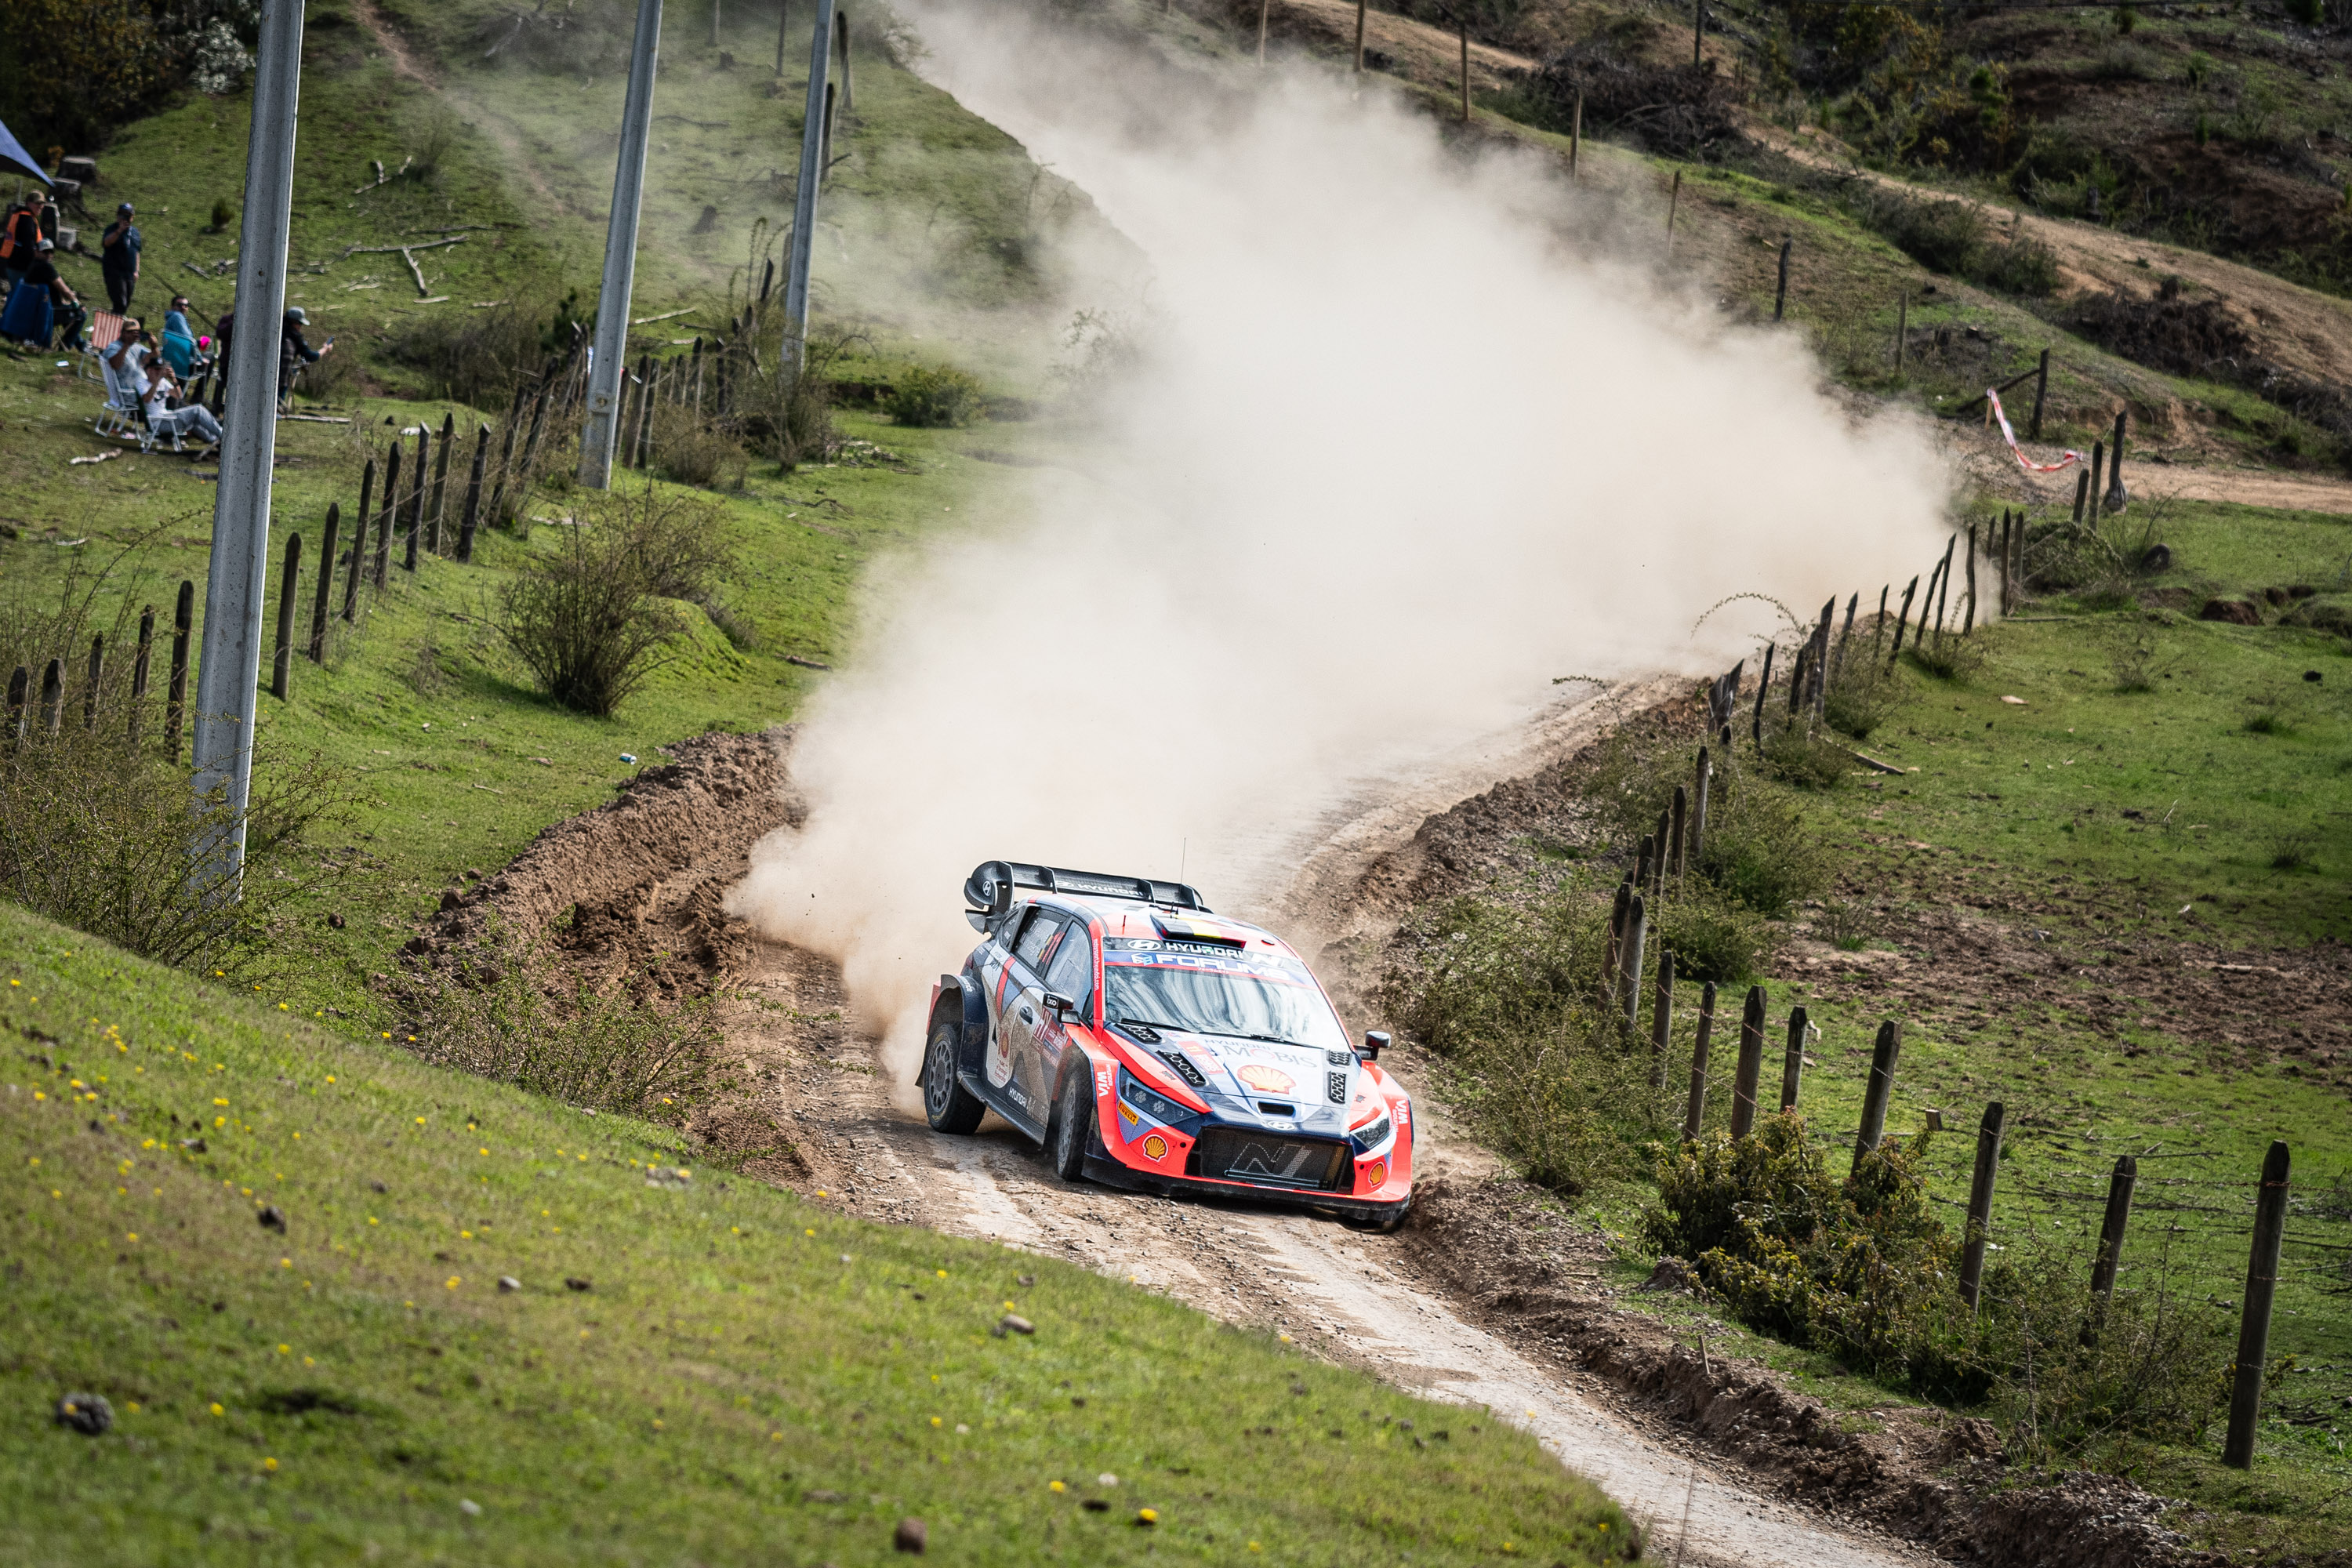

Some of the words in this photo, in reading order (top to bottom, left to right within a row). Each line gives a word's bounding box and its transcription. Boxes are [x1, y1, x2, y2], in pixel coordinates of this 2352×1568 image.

[1165, 942, 1244, 959] HYUNDAI
[1203, 1038, 1272, 1051] HYUNDAI
[1223, 1045, 1318, 1068] MOBIS
[1119, 1101, 1137, 1123] PIRELLI
